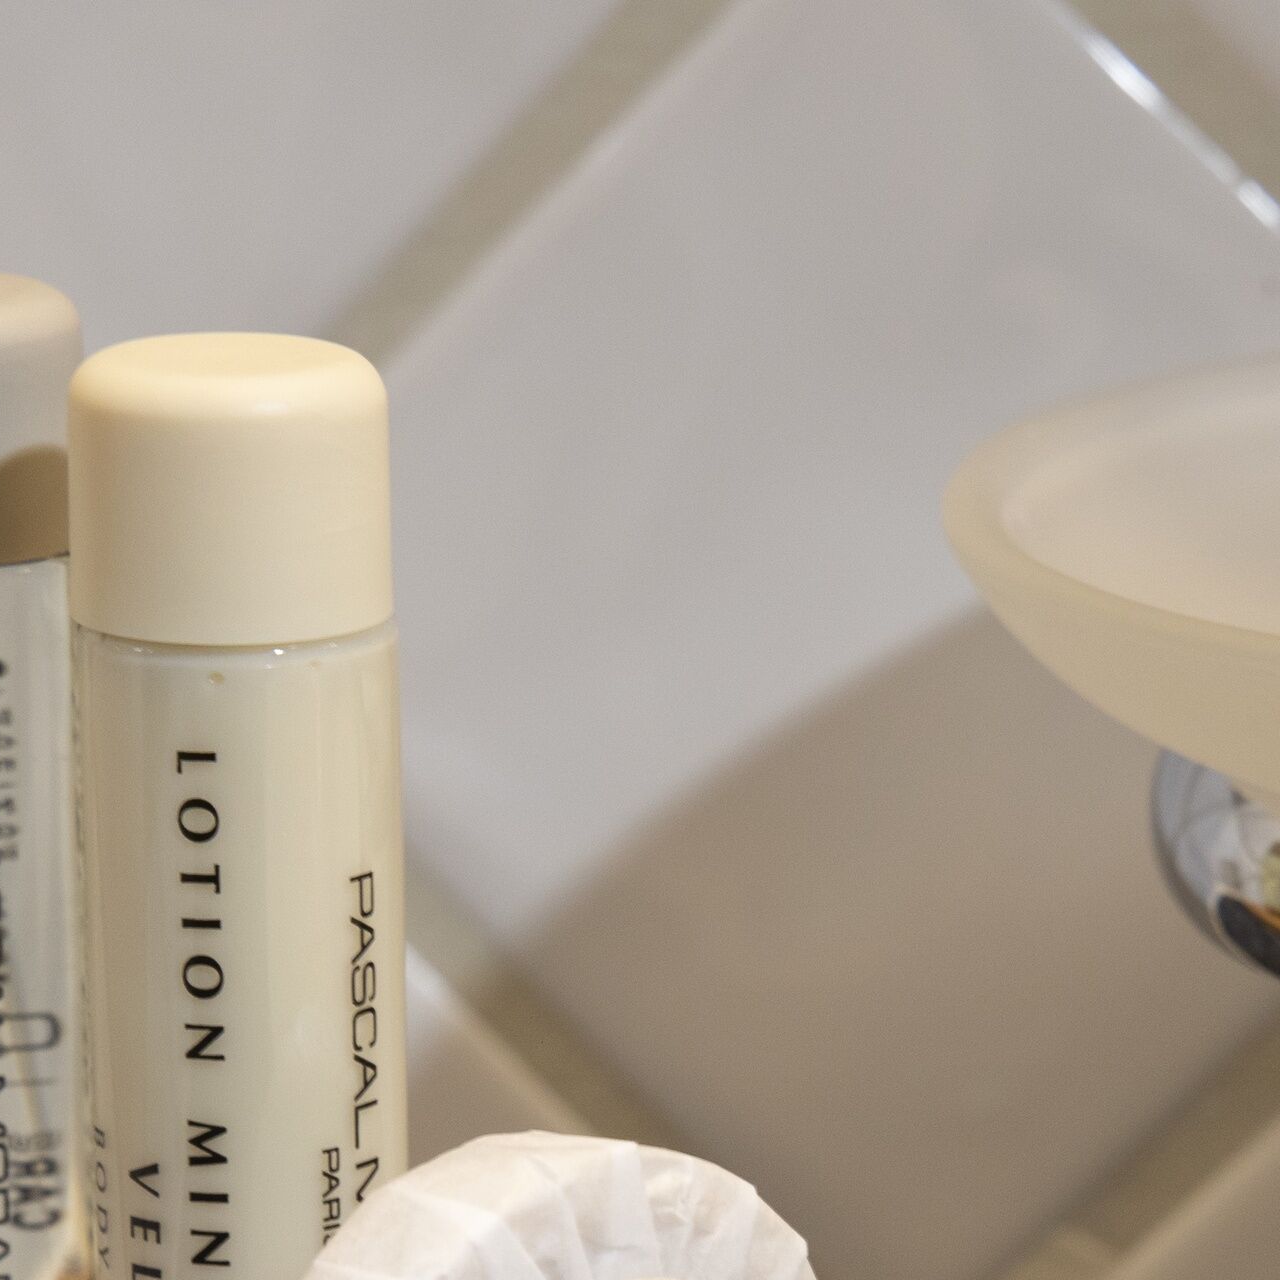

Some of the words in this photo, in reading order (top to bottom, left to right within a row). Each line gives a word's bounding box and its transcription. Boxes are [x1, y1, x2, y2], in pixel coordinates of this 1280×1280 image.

[176, 750, 225, 1061] LOTION
[349, 871, 379, 1150] PASCAL
[92, 1124, 112, 1271] BODY
